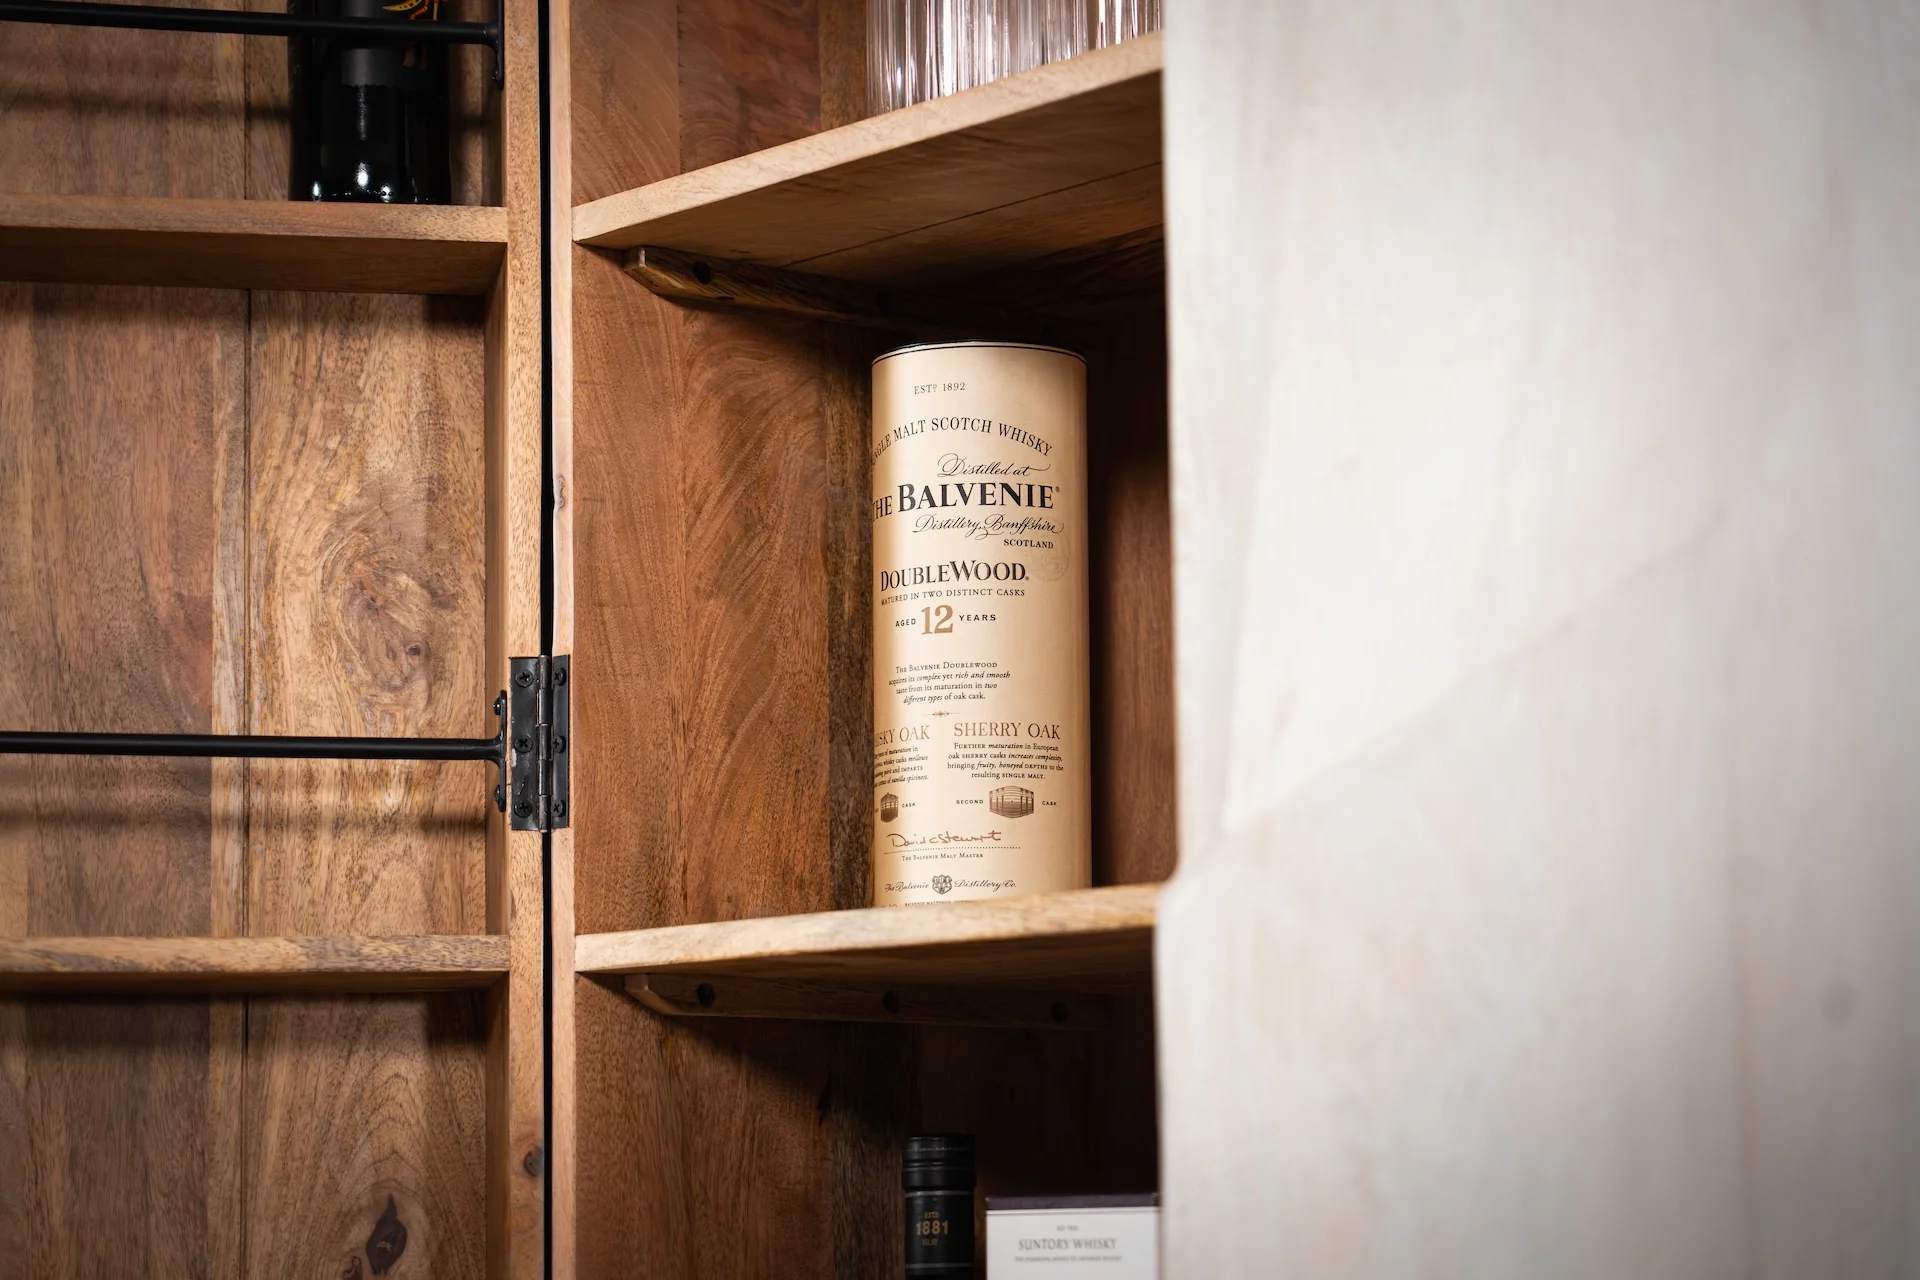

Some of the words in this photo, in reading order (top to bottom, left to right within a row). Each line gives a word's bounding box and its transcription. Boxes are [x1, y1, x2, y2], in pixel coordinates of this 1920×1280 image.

[942, 382, 966, 392] 1892
[893, 419, 926, 441] MALT
[931, 416, 993, 434] SCOTCH
[998, 422, 1053, 457] WHISKY
[937, 453, 1013, 478] Distilled
[1012, 463, 1051, 477] at
[975, 513, 1065, 541] Banffshire
[1003, 538, 1054, 549] SCOTLAND
[881, 593, 908, 606] MATURED
[910, 592, 920, 600] IN
[923, 590, 942, 599] TWO
[946, 588, 993, 597] DISTINCT
[996, 588, 1025, 597] CASKS
[895, 618, 916, 627] AGED
[921, 604, 954, 635] 12
[959, 614, 997, 622] YEARS
[917, 672, 941, 683] complex
[942, 673, 953, 682] yet
[955, 671, 969, 679] rich
[971, 670, 984, 679] and
[986, 670, 1011, 679] smooth
[908, 684, 923, 693] from
[924, 683, 933, 691] its
[934, 682, 973, 691] maturation
[975, 681, 983, 689] in
[903, 695, 926, 706] different
[927, 694, 943, 704] types
[944, 692, 953, 700] of
[953, 692, 967, 700] oak
[968, 691, 986, 700] cask.
[899, 725, 931, 742] OAK
[953, 722, 1021, 737] SHERRY
[1027, 722, 1060, 740] OAK
[1033, 743, 1059, 752] European
[947, 762, 975, 770] bringing
[976, 761, 996, 770] fruity,
[998, 762, 1023, 770] honeyed
[1055, 763, 1064, 771] the
[971, 770, 1001, 779] resulting
[895, 881, 930, 893] Balvenie
[954, 879, 1001, 893] Distillery
[916, 1220, 949, 1236] 1881
[1018, 1239, 1068, 1250] SUNTORY
[1073, 1237, 1117, 1249] WHISKY
